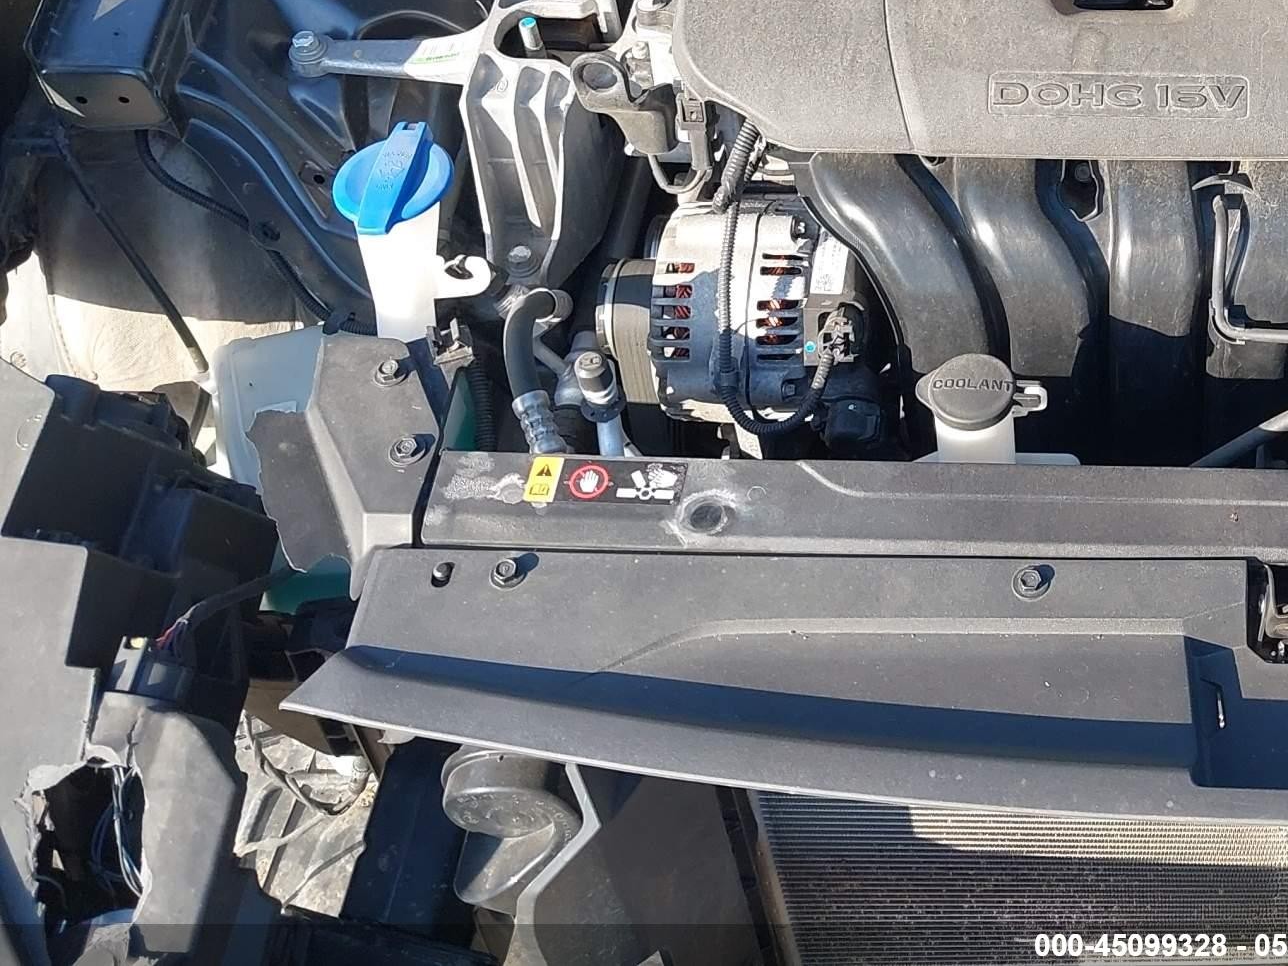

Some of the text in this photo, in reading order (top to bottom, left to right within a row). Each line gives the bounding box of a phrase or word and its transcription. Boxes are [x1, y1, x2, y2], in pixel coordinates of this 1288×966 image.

[993, 81, 1246, 110] DOHC 16V
[933, 378, 1014, 393] COOLANT
